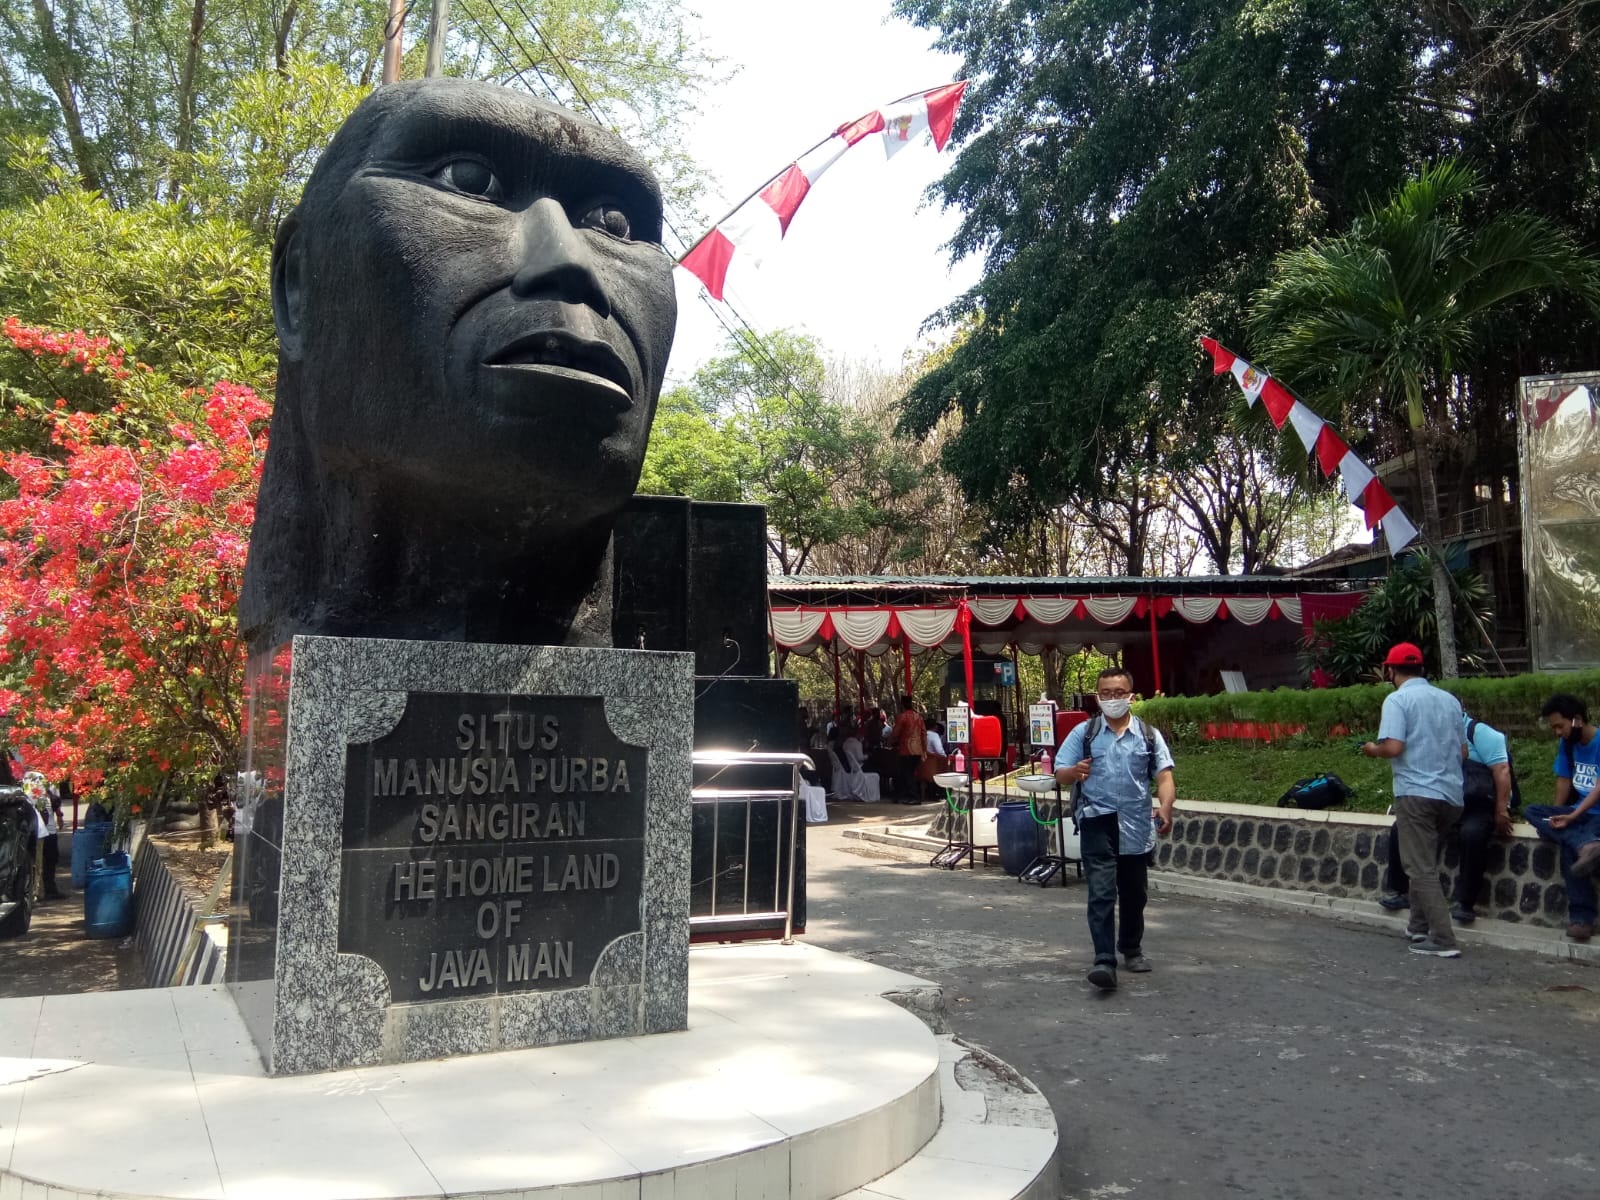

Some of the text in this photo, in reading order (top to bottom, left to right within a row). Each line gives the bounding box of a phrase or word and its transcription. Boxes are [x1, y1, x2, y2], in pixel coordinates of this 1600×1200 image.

[1003, 666, 1012, 682] P
[456, 712, 559, 751] SITUS
[373, 758, 631, 797] MANUSIA PURBA
[419, 802, 585, 842] SANGIRAN
[393, 853, 620, 902] HE HOME LAND
[476, 901, 522, 939] OF
[419, 942, 574, 991] JAVA MAN
